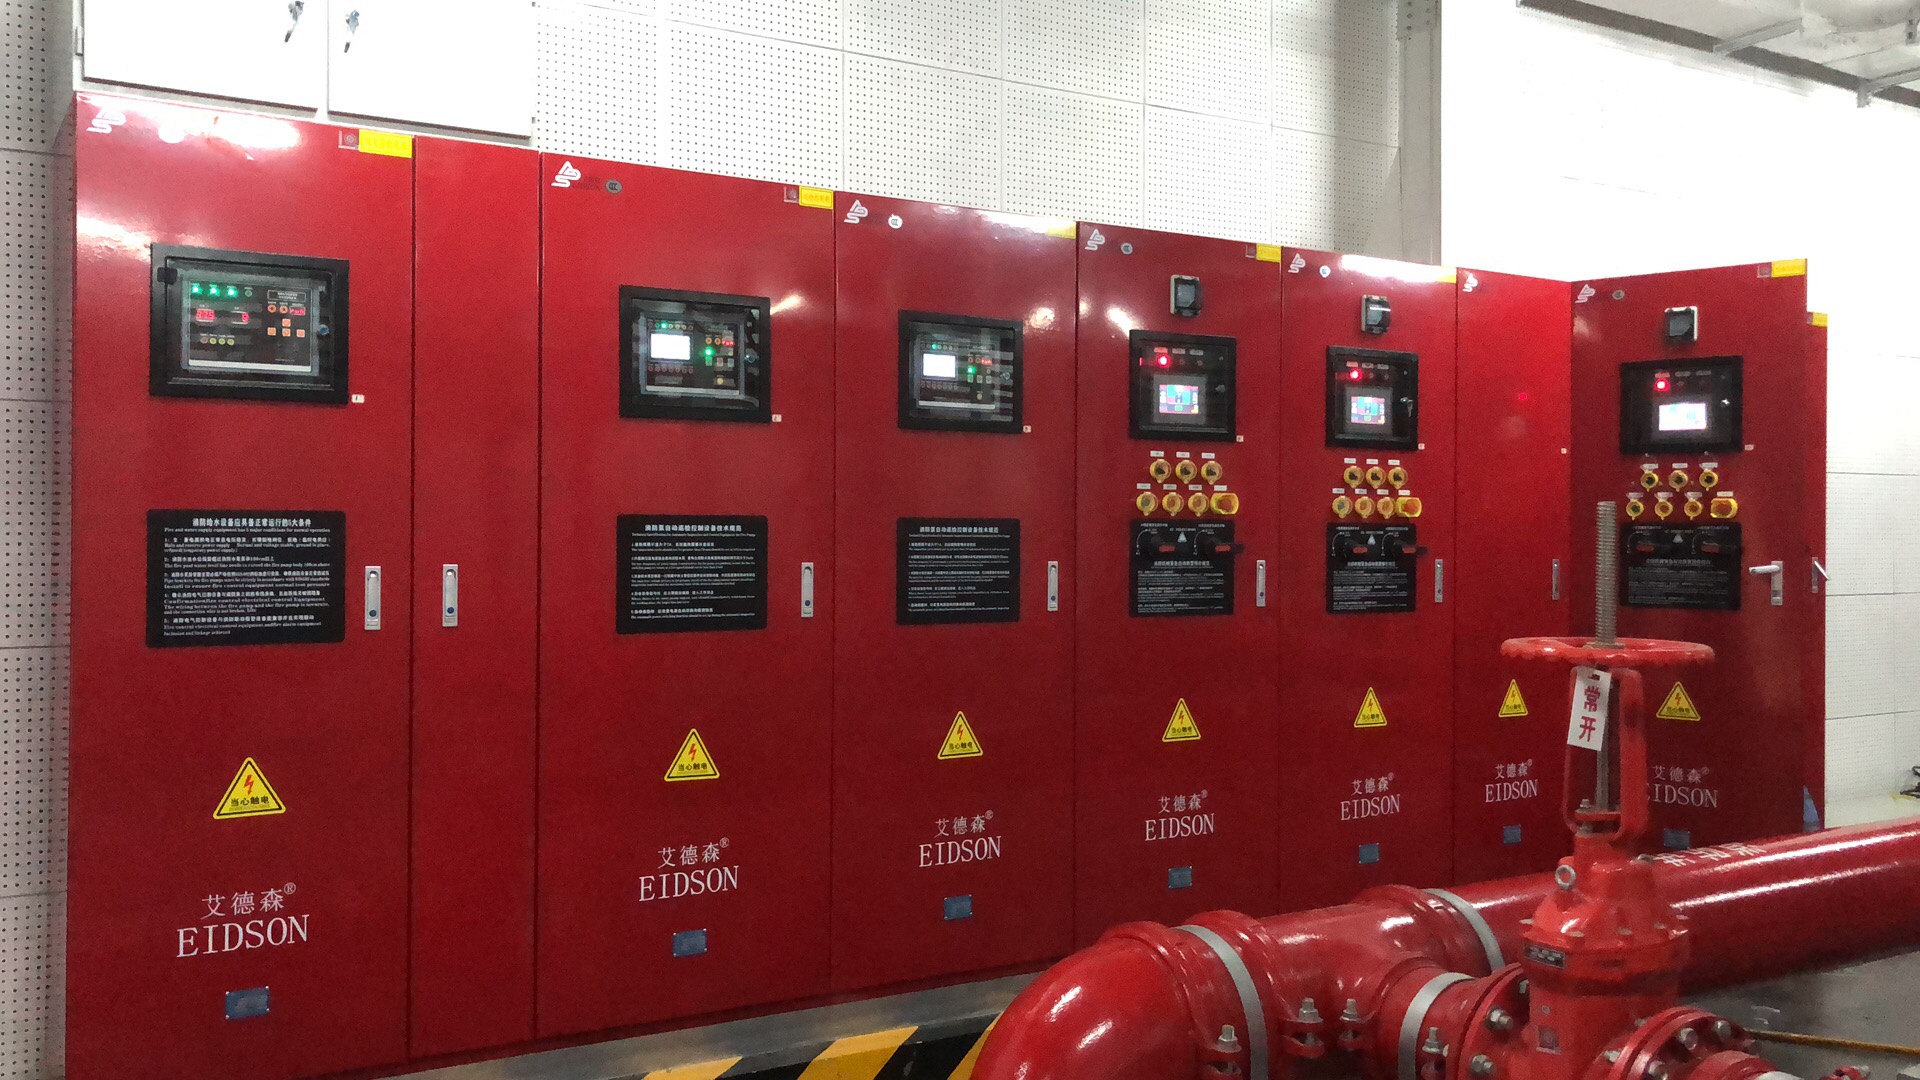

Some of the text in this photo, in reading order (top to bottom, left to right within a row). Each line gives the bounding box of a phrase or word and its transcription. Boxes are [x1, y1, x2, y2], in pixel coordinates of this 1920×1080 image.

[1579, 686, 1600, 742] 常开
[678, 763, 708, 771] 当心触电
[230, 796, 270, 806] 当心触电
[1485, 779, 1538, 802] EIDSON
[1646, 783, 1718, 808] IDSON
[1340, 794, 1401, 821] EIDSON
[1145, 813, 1215, 841] EIDSON
[919, 836, 1002, 867] EIDSON
[638, 865, 739, 902] EIDSON
[176, 914, 310, 958] EIDSON
